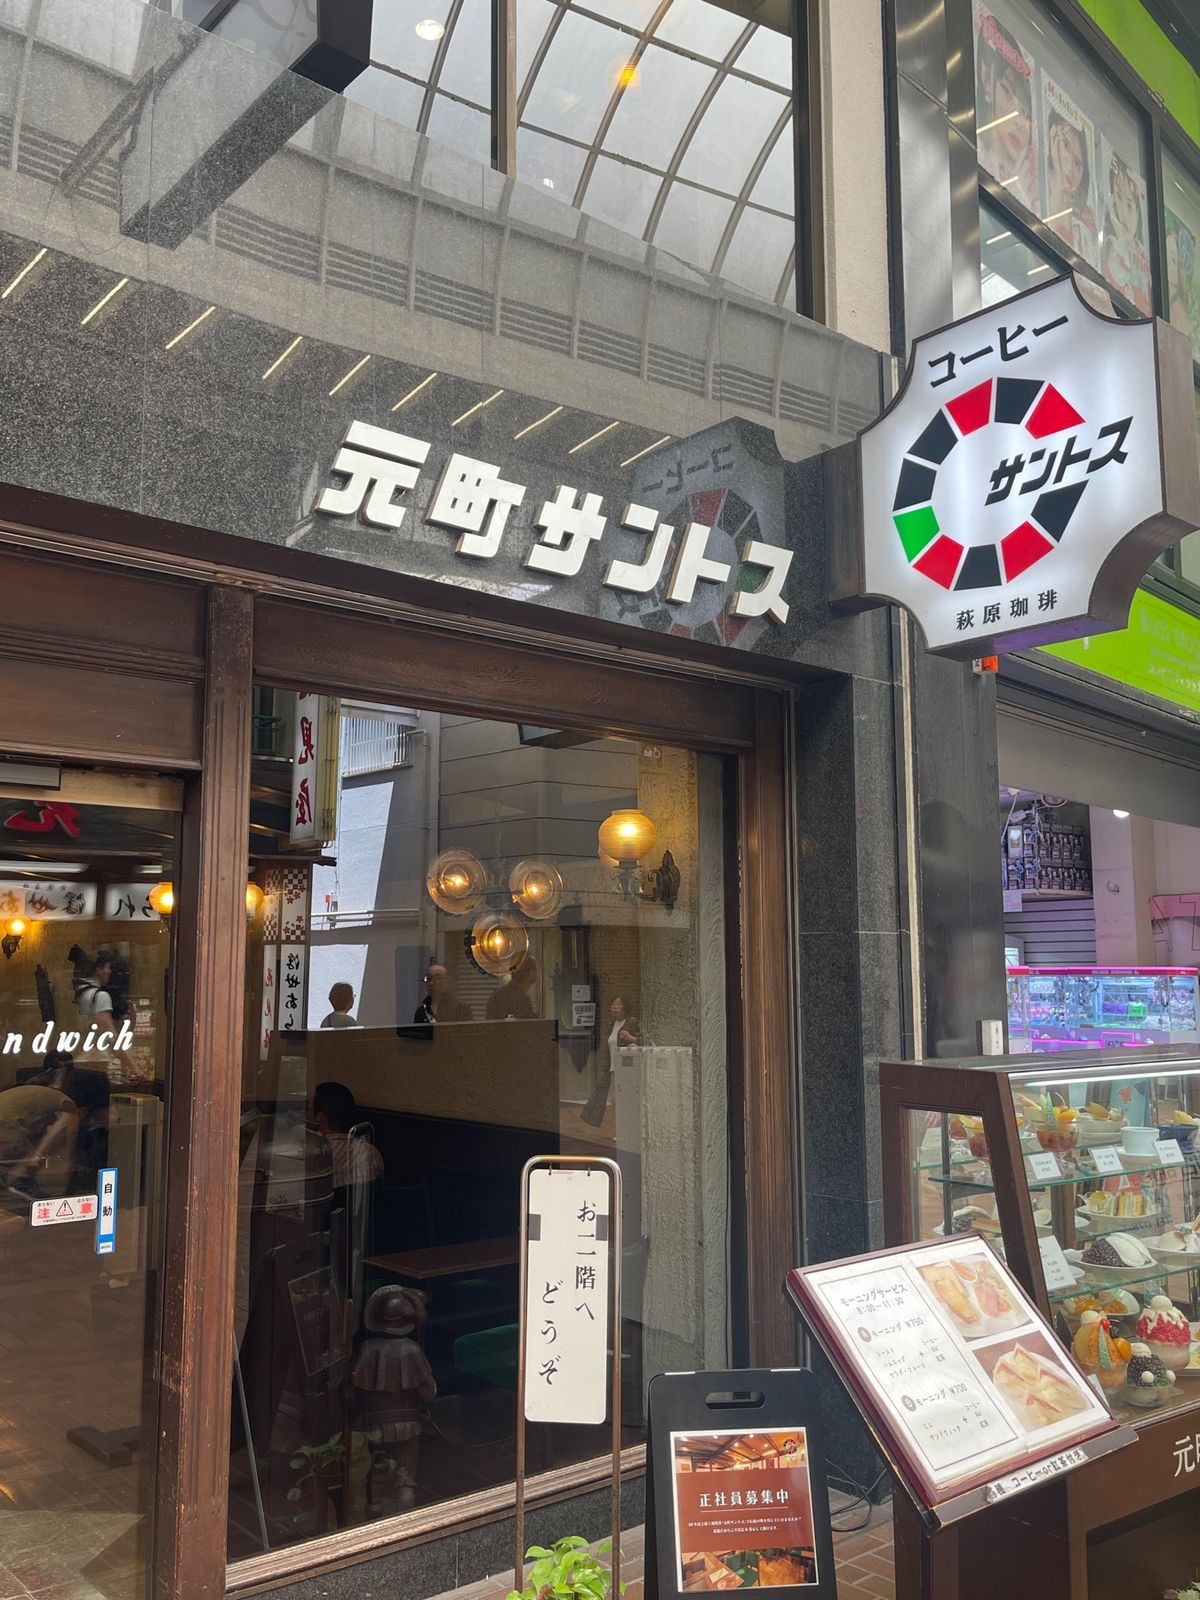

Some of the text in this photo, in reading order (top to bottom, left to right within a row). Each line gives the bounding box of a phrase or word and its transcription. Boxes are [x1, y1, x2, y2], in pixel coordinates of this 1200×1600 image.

[928, 315, 1069, 388] コーヒー
[985, 416, 1133, 506] サントス
[315, 419, 794, 624] 元町サントス
[956, 589, 1058, 631] 萩原珈琲
[2, 1019, 133, 1054] ndwich
[102, 1183, 113, 1217] 自動
[575, 1199, 596, 1321] お二階へ
[839, 1283, 908, 1306] モーニングサービス
[538, 1279, 563, 1385] どうぞ
[871, 1322, 901, 1337] モーニング
[915, 1388, 946, 1406] モーニング
[699, 1488, 789, 1507] 正社員募集中
